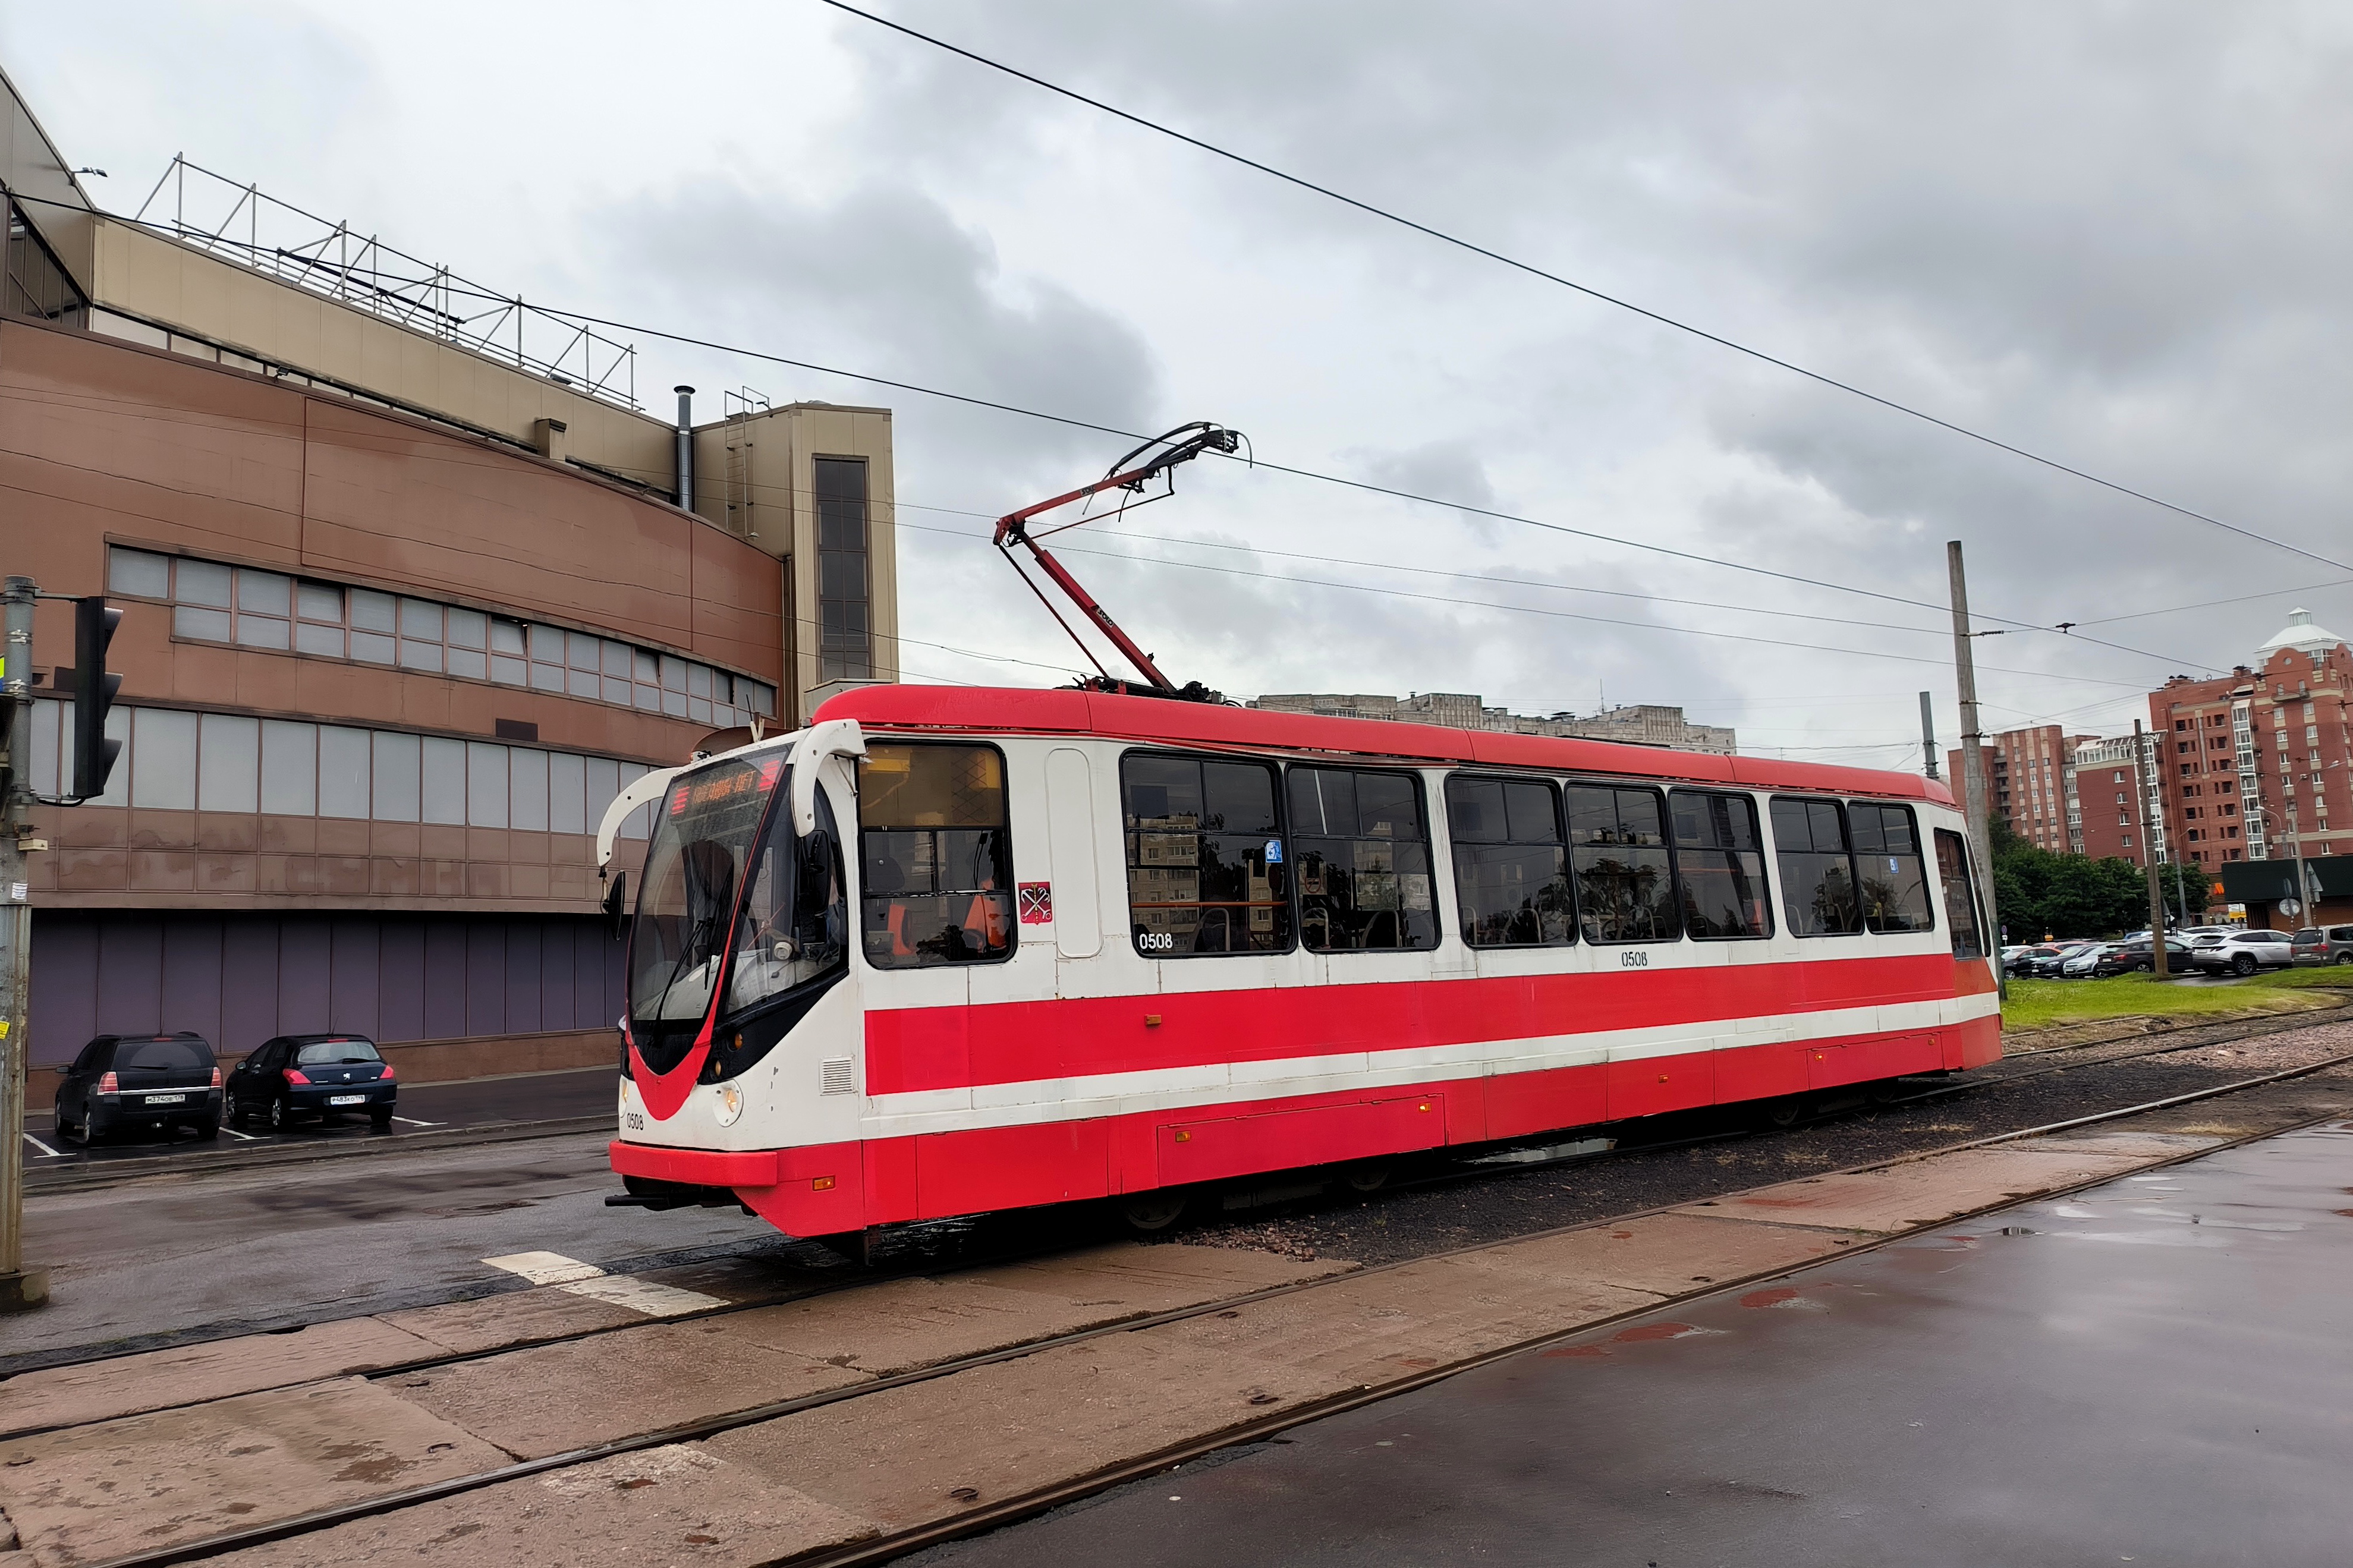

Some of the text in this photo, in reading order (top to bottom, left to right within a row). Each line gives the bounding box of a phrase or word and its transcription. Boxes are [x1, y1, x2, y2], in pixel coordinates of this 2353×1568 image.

[1097, 610, 1113, 626] SOLO
[1139, 933, 1173, 949] 0508
[1621, 951, 1647, 966] 0508
[627, 1112, 643, 1131] 0508
